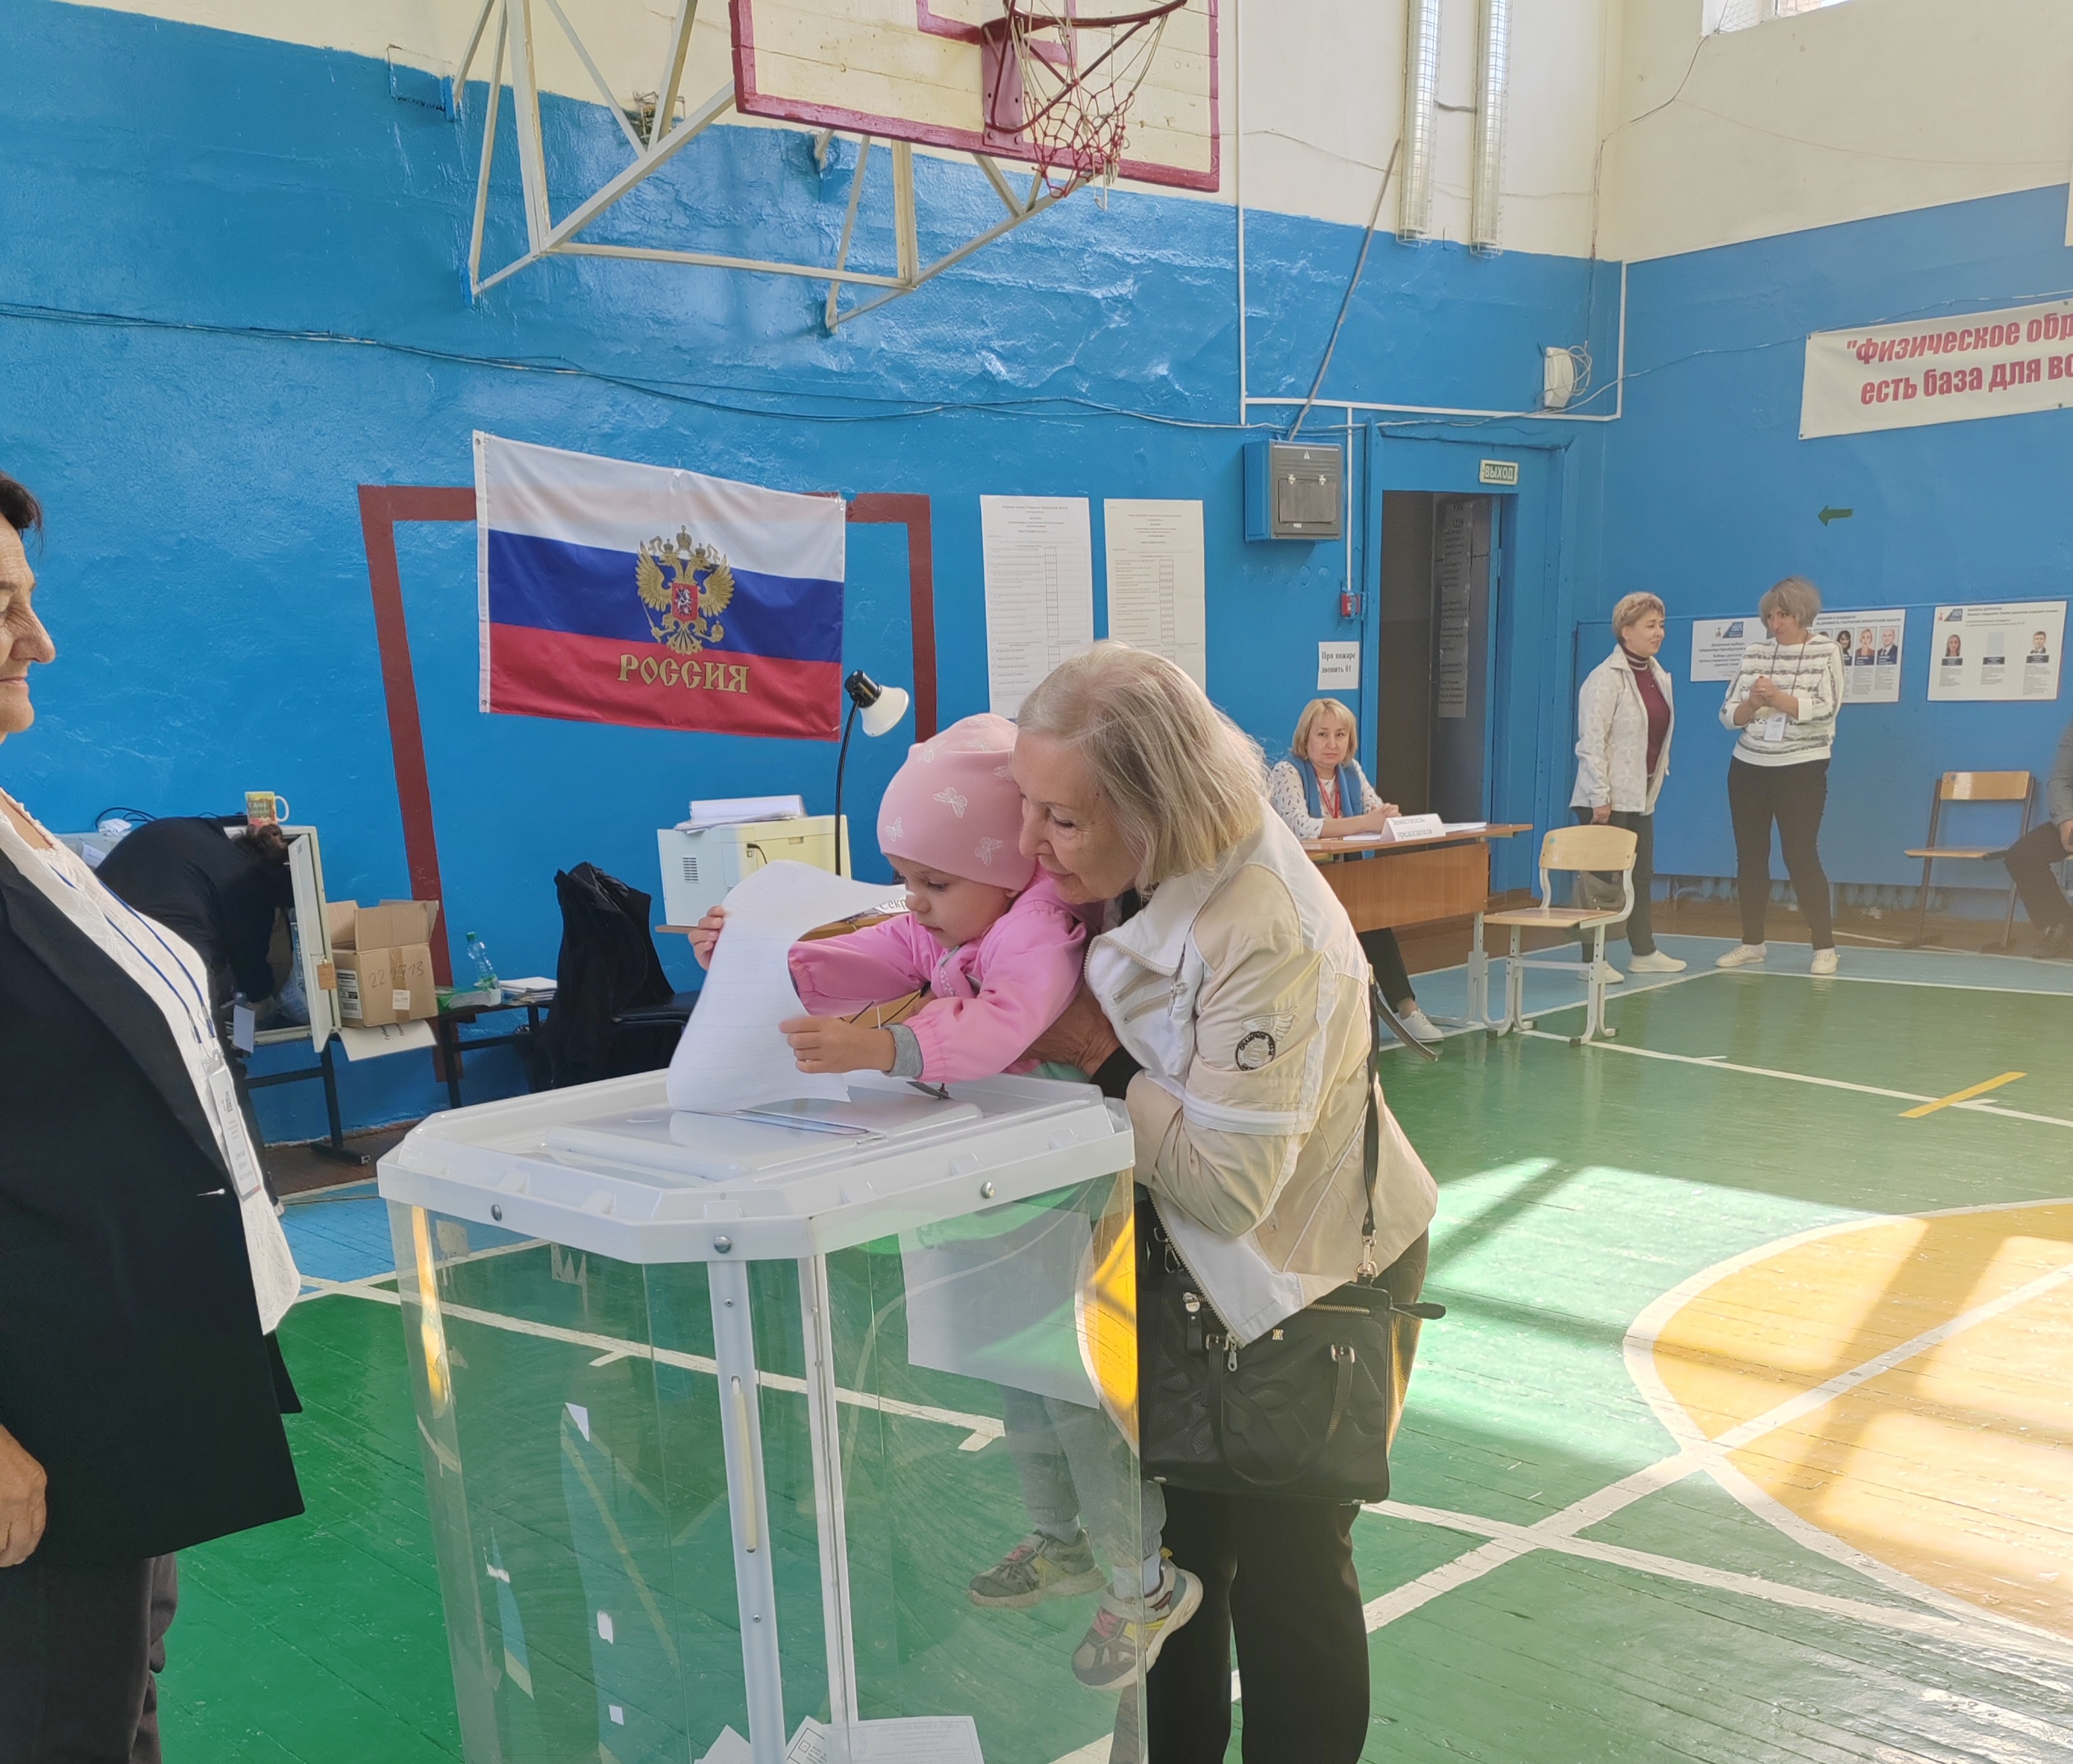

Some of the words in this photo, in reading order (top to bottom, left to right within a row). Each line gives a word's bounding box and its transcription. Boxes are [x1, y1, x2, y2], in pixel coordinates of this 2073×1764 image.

[1860, 377, 1917, 405] есть
[1923, 367, 1983, 397] база
[1988, 358, 2041, 392] для
[1484, 465, 1514, 481] ВЫХОД
[1321, 652, 1334, 661] При
[617, 654, 750, 694] РОССИЯ
[1345, 665, 1351, 673] 01
